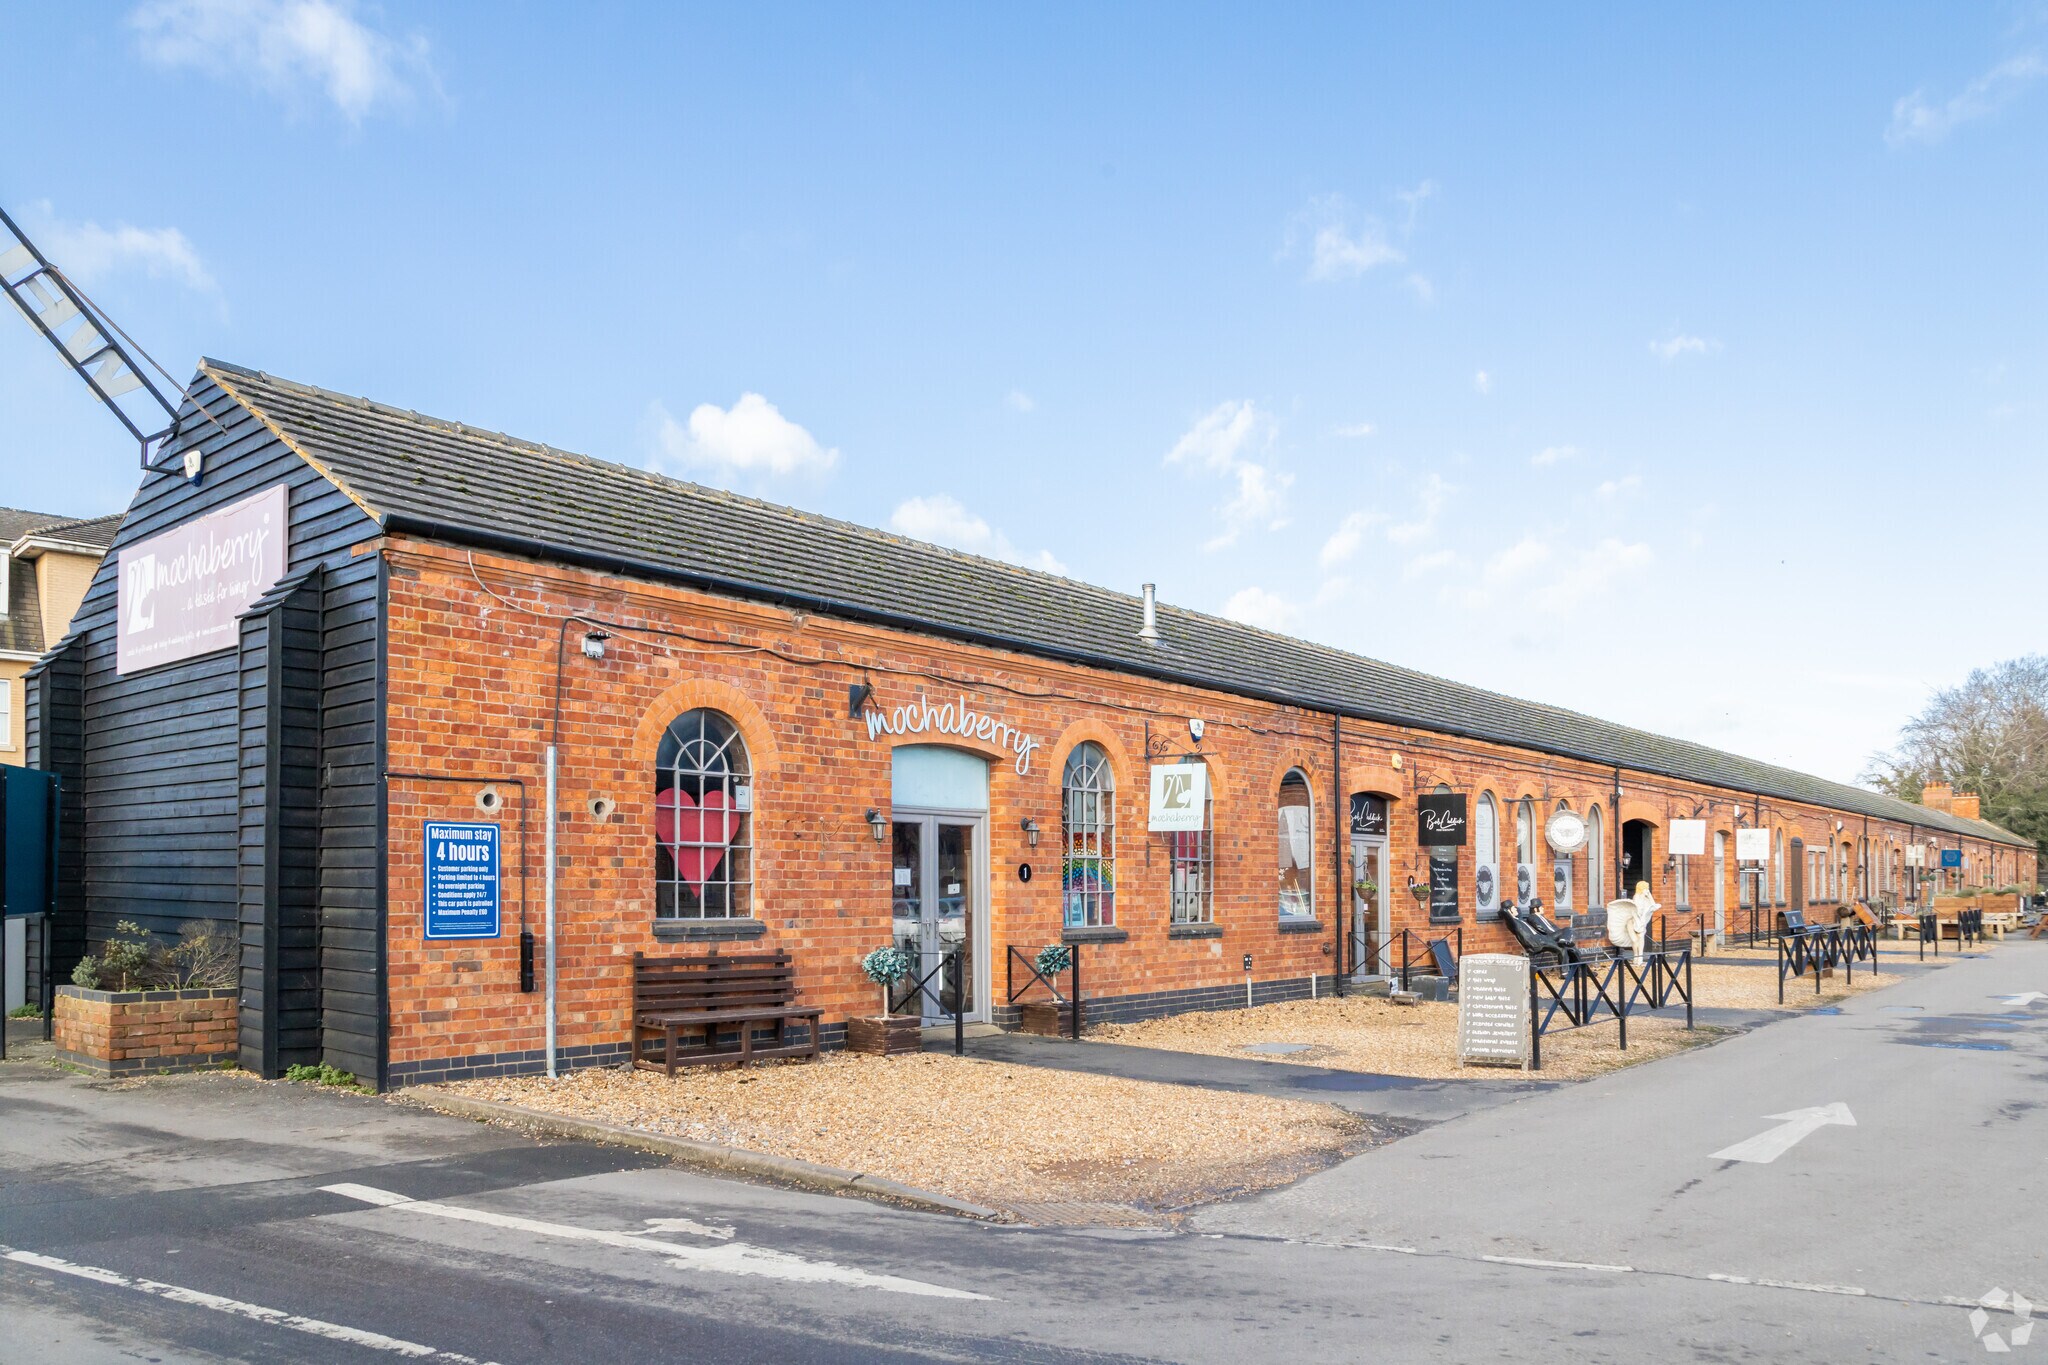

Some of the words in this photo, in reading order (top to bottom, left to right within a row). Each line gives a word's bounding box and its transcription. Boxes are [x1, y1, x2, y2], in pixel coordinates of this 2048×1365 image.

[156, 525, 270, 586] mochaberry
[217, 582, 228, 604] for
[865, 694, 1040, 776] mochaberry
[1151, 812, 1202, 827] mochaberry
[432, 828, 473, 840] Maximum
[475, 829, 492, 842] stay
[436, 842, 446, 861] 4
[449, 842, 489, 861] hours
[1024, 866, 1027, 878] 1
